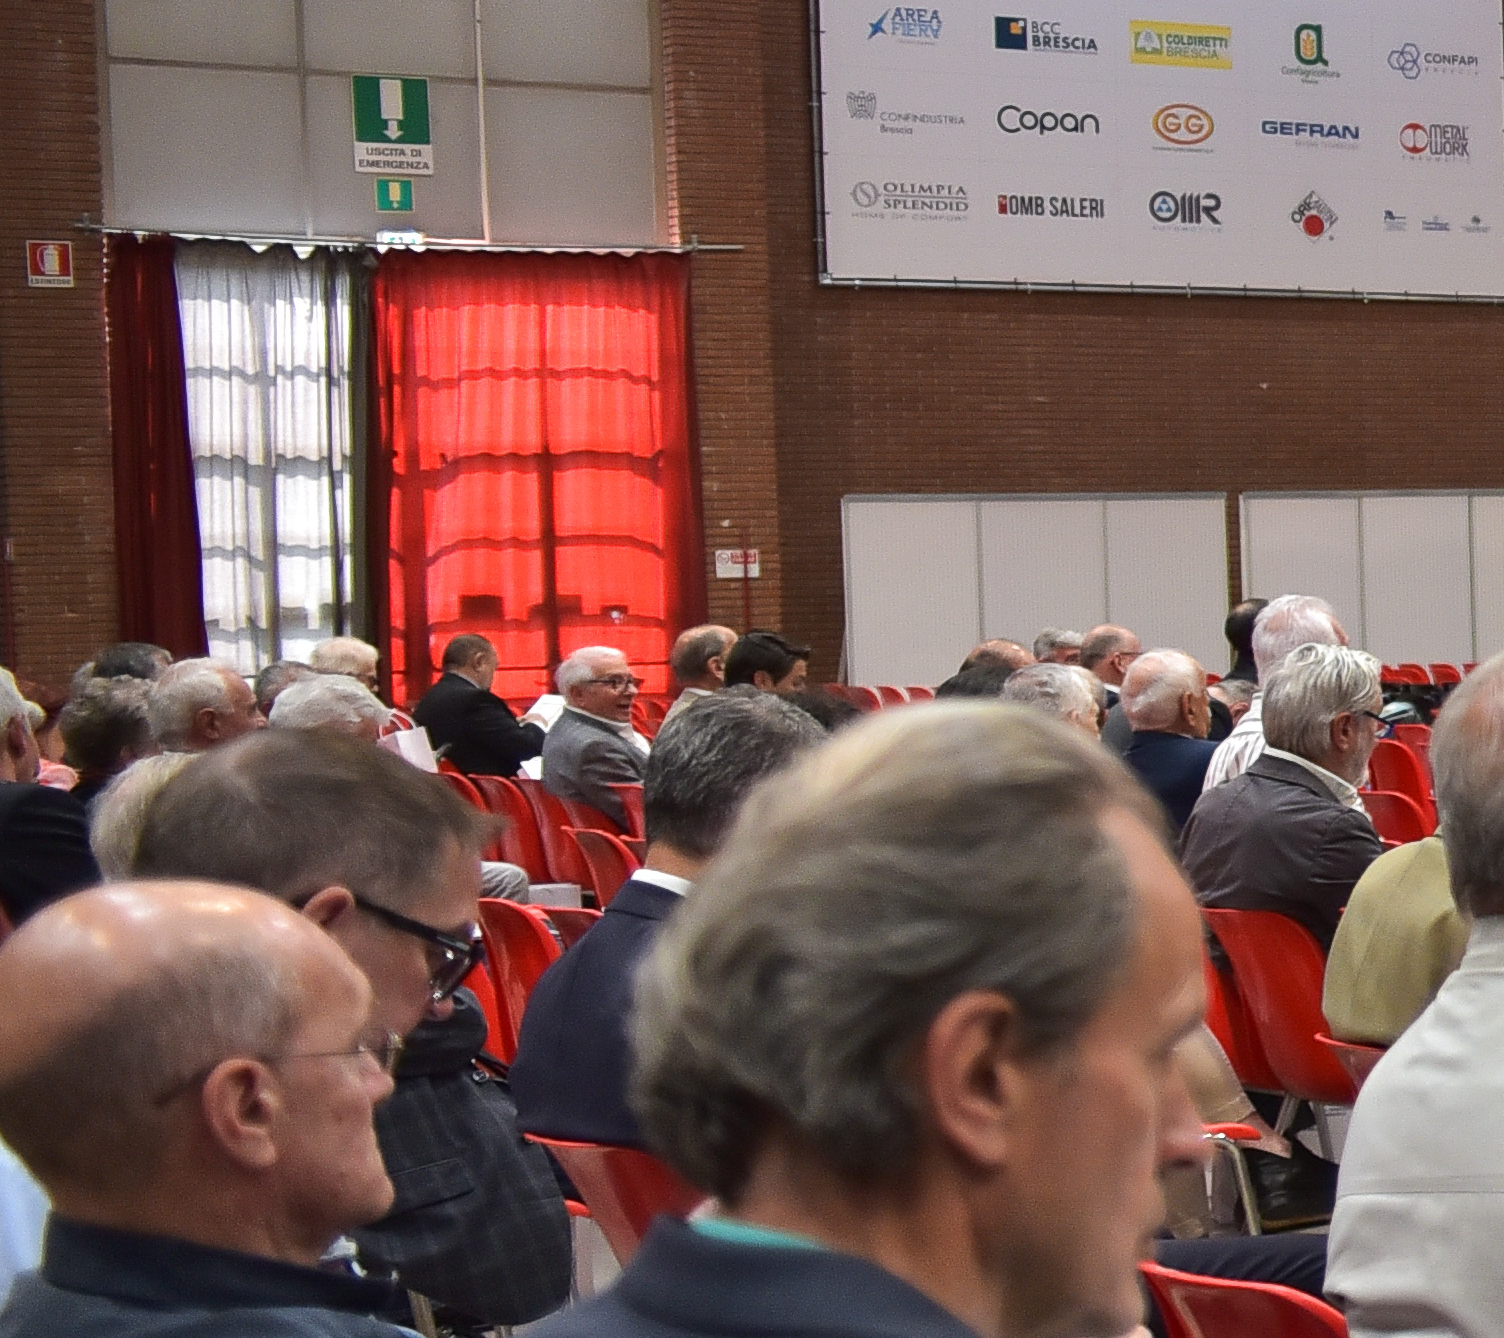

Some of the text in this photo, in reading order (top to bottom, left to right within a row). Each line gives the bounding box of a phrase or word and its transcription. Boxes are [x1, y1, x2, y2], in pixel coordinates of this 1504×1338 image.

[891, 7, 942, 24] AREA
[1031, 21, 1061, 35] BCC
[1032, 34, 1098, 51] BRESCIA
[1165, 33, 1228, 49] COLDIRETTI
[1166, 45, 1219, 61] BRESCIA
[1424, 52, 1479, 68] CONFAPI
[880, 111, 965, 126] CONFINDUSTRIA
[997, 104, 1100, 135] Copan
[1261, 120, 1360, 140] GEFRAN
[1429, 124, 1468, 142] METAL
[365, 146, 422, 158] USCITA DI
[1430, 141, 1470, 157] WORK
[358, 158, 430, 170] EMERGENZA
[883, 182, 967, 196] OLIMPIA
[884, 198, 969, 212] SPLENDID
[1009, 195, 1105, 218] OMB SALERI
